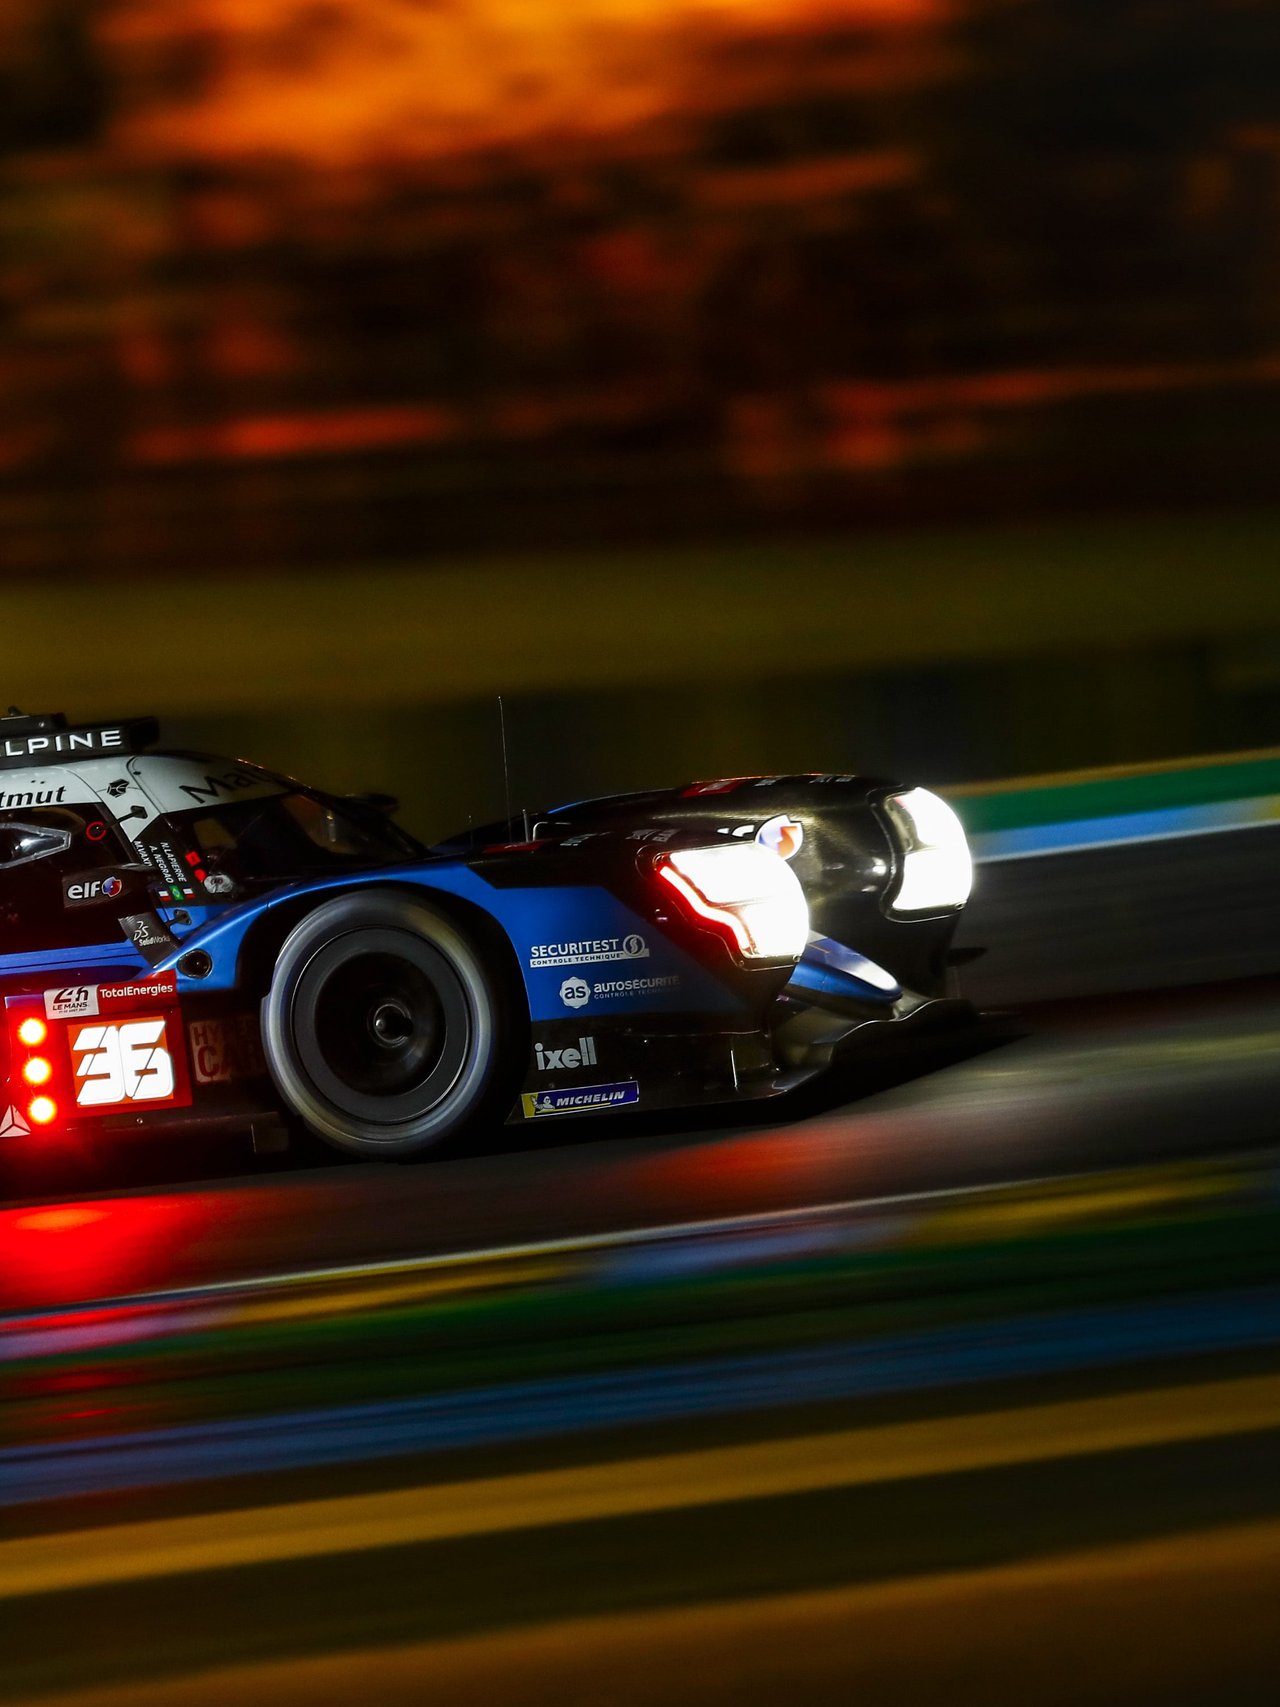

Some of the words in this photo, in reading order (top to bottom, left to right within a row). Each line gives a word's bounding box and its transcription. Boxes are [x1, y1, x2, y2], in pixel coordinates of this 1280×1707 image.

[67, 880, 101, 900] elf
[530, 938, 620, 958] SECURITEST
[99, 983, 174, 998] TotalEnergies
[63, 1002, 88, 1010] MANS
[72, 1020, 174, 1106] 36
[534, 1036, 598, 1071] ixell
[555, 1090, 625, 1108] MICHELIN
